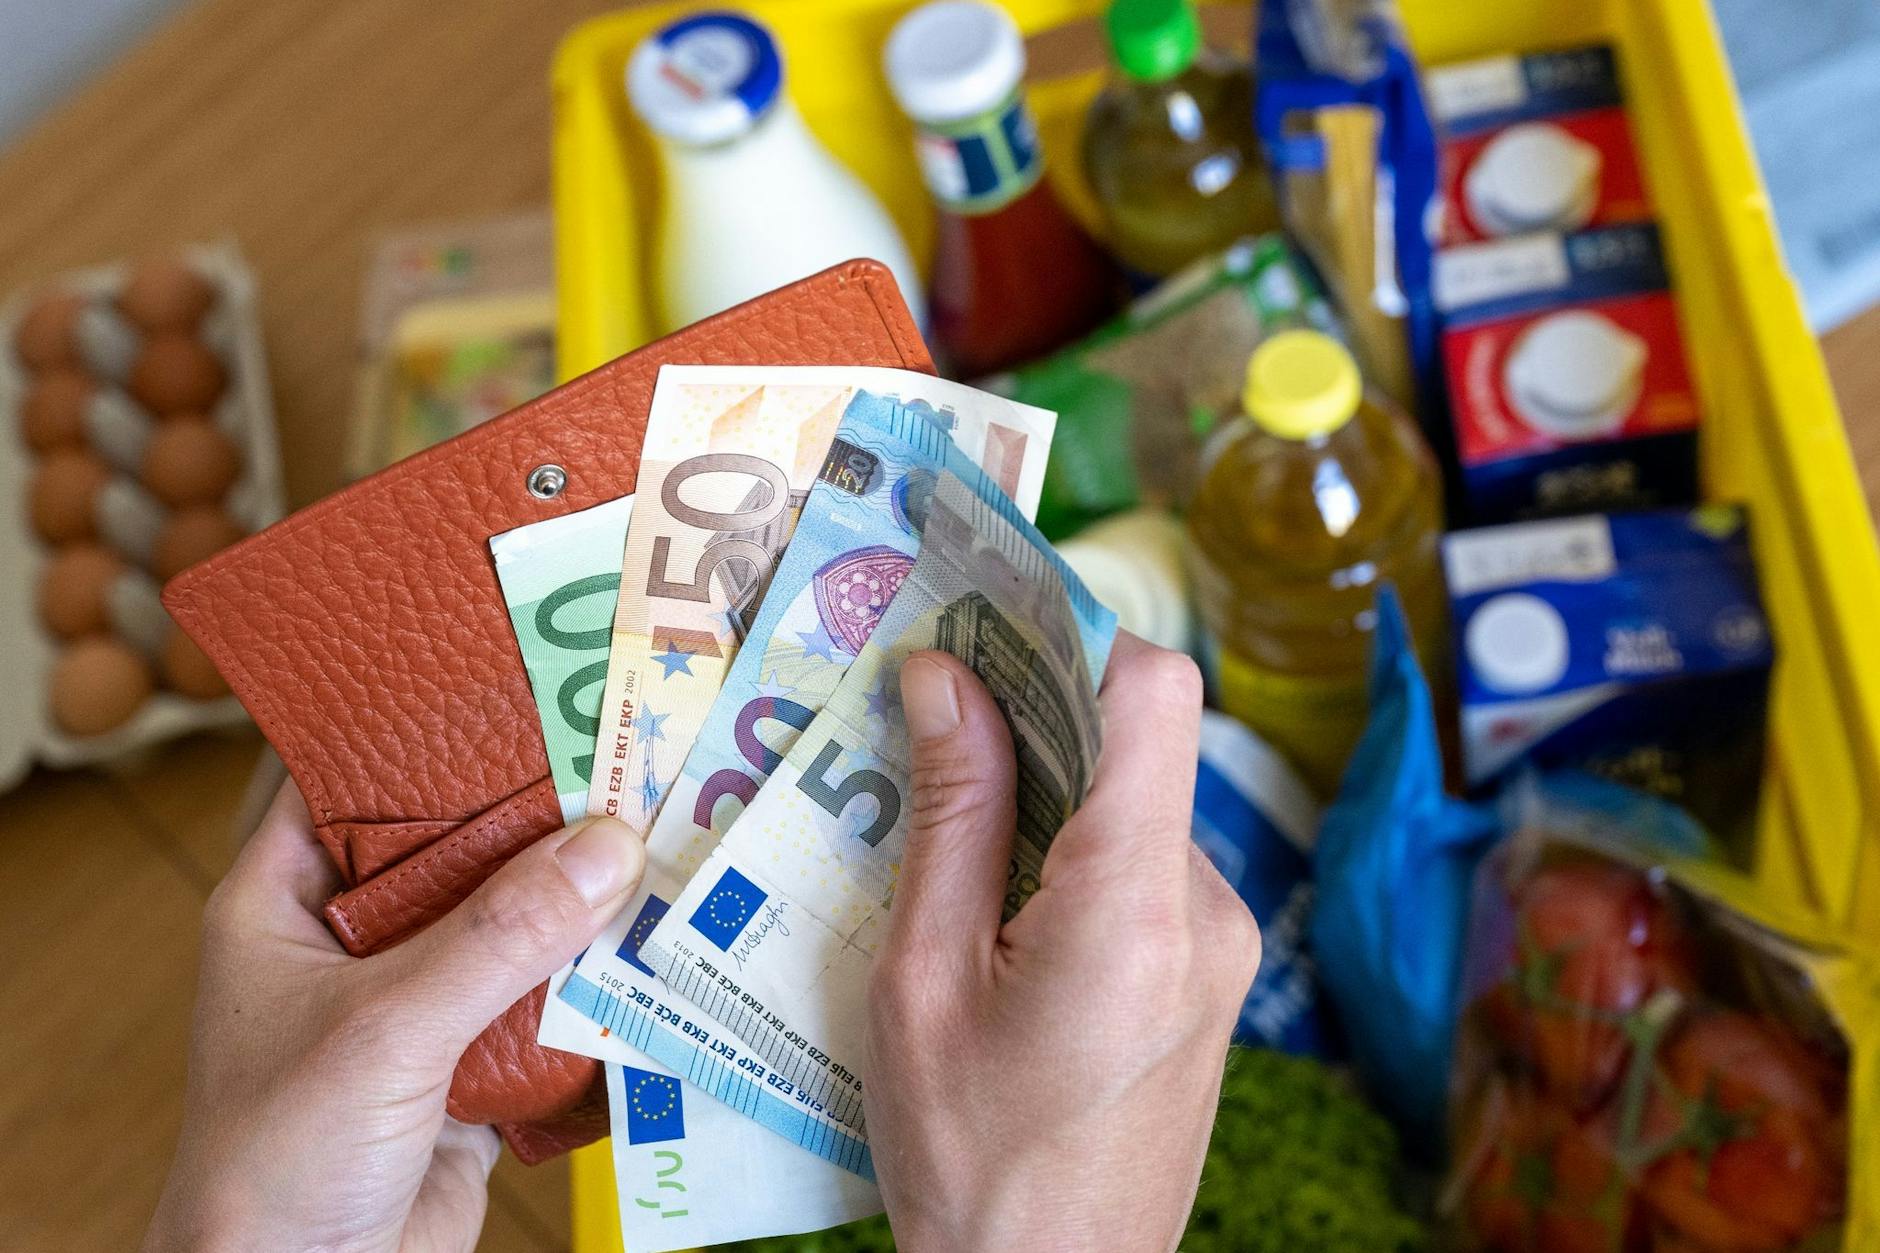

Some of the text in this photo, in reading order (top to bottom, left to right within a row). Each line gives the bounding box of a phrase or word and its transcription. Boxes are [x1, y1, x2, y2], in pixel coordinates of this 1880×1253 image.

[646, 453, 790, 612] 50
[606, 670, 636, 816] CB EZB EKT EKP 2002
[795, 738, 901, 848] 5
[673, 940, 694, 959] 2013
[695, 956, 718, 979] EBC
[599, 971, 625, 992] 2015
[626, 986, 654, 1009] EBC
[741, 993, 764, 1014] EKB
[682, 1021, 709, 1044] EKB
[763, 1011, 785, 1032] EKT
[709, 1039, 737, 1061] EKT
[785, 1031, 808, 1051] EKP
[807, 1046, 831, 1067] EZB
[737, 1057, 765, 1079] EKP
[767, 1072, 795, 1095] EZB
